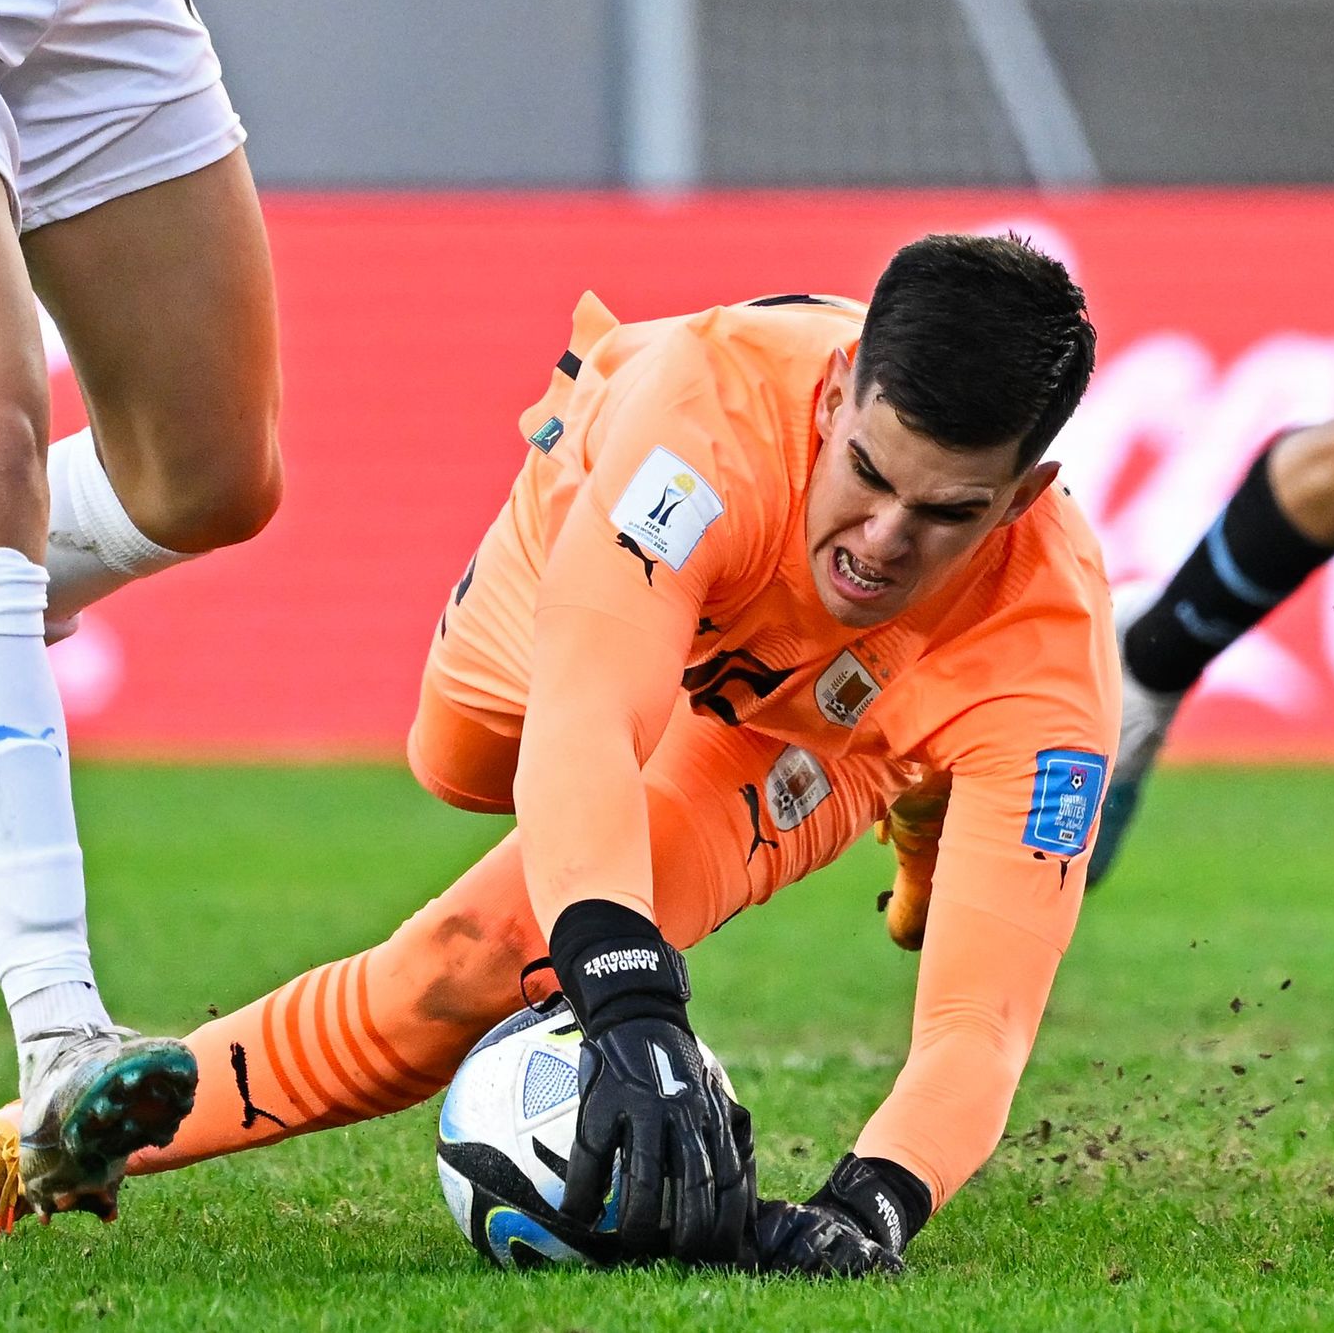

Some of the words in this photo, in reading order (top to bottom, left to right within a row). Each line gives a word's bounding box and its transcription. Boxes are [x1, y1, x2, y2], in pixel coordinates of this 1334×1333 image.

[644, 520, 662, 534] FIFA
[1058, 800, 1086, 820] UNITES
[583, 949, 659, 975] RODRIGUEZ
[591, 959, 658, 978] RANDALL
